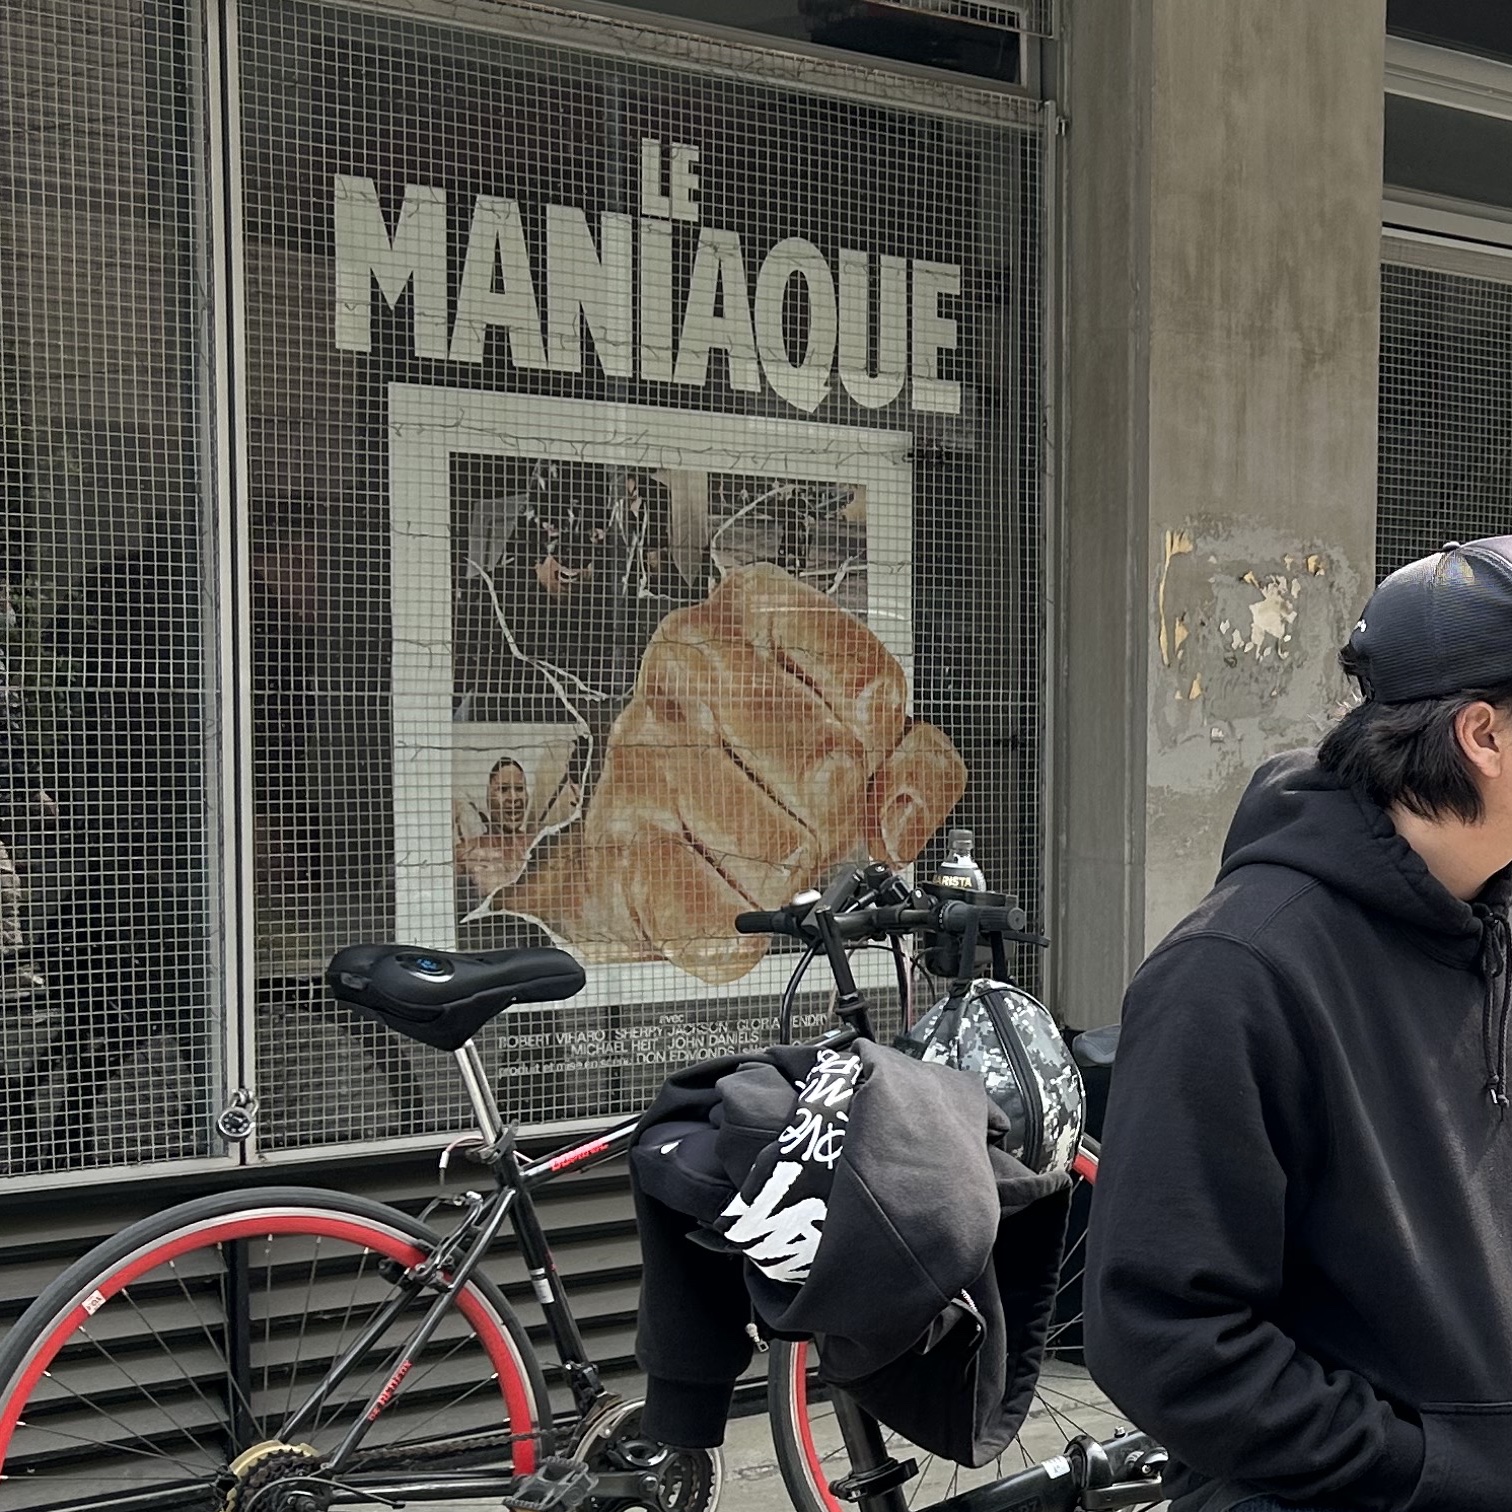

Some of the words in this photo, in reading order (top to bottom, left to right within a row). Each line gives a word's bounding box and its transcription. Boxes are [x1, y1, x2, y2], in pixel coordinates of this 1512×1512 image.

[641, 137, 700, 222] LE
[333, 174, 962, 414] MANIAQUE
[499, 1033, 551, 1048] ROBERT
[737, 1018, 780, 1031] GLORA
[792, 1013, 828, 1028] ENDRY
[571, 1041, 628, 1056] MICHAEL
[667, 1034, 704, 1049] JOHN
[708, 1031, 759, 1046] DANIELS
[636, 1051, 666, 1064] DON
